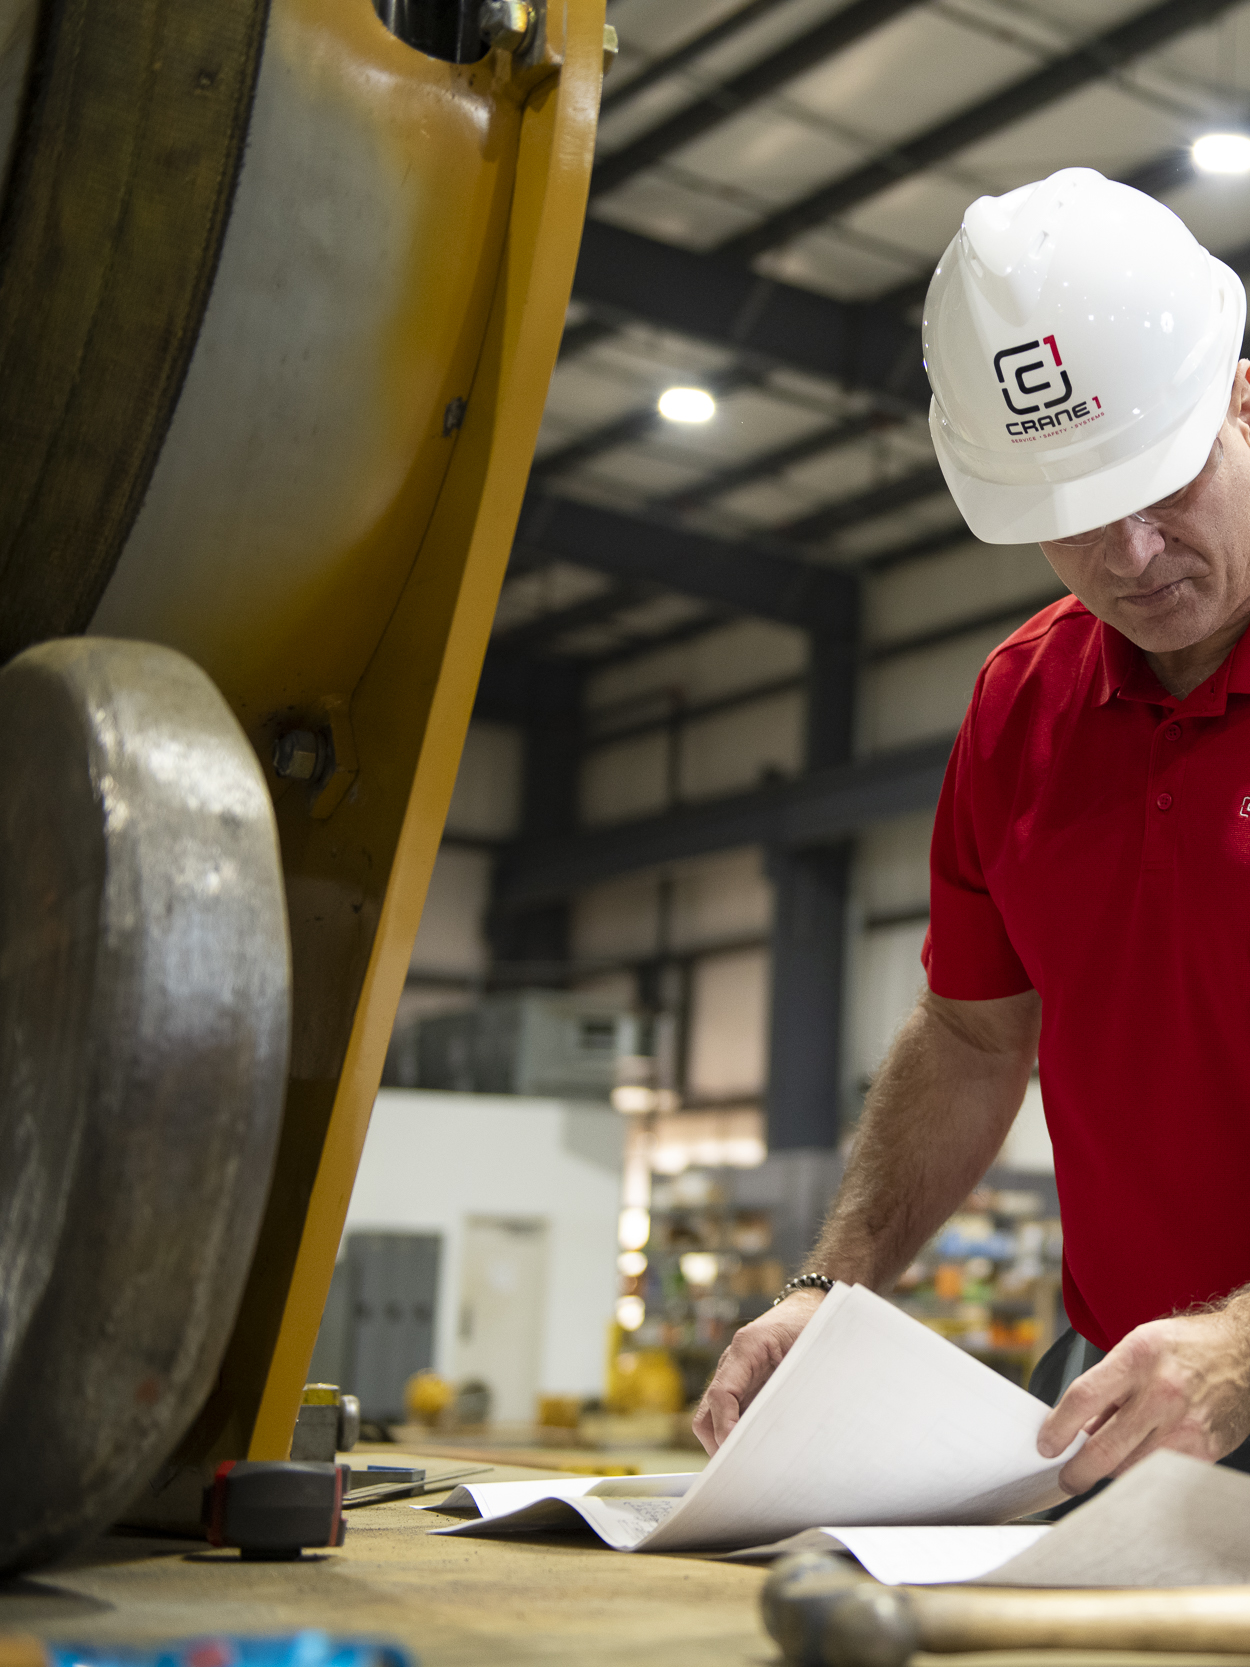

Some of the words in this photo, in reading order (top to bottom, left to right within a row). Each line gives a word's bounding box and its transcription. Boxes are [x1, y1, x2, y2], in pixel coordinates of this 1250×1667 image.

[1006, 401, 1090, 435] CRANE
[1092, 396, 1101, 409] 1
[1011, 436, 1036, 444] SERVICE
[1043, 428, 1068, 438] SAFETY
[1075, 412, 1105, 428] SYSTEMS
